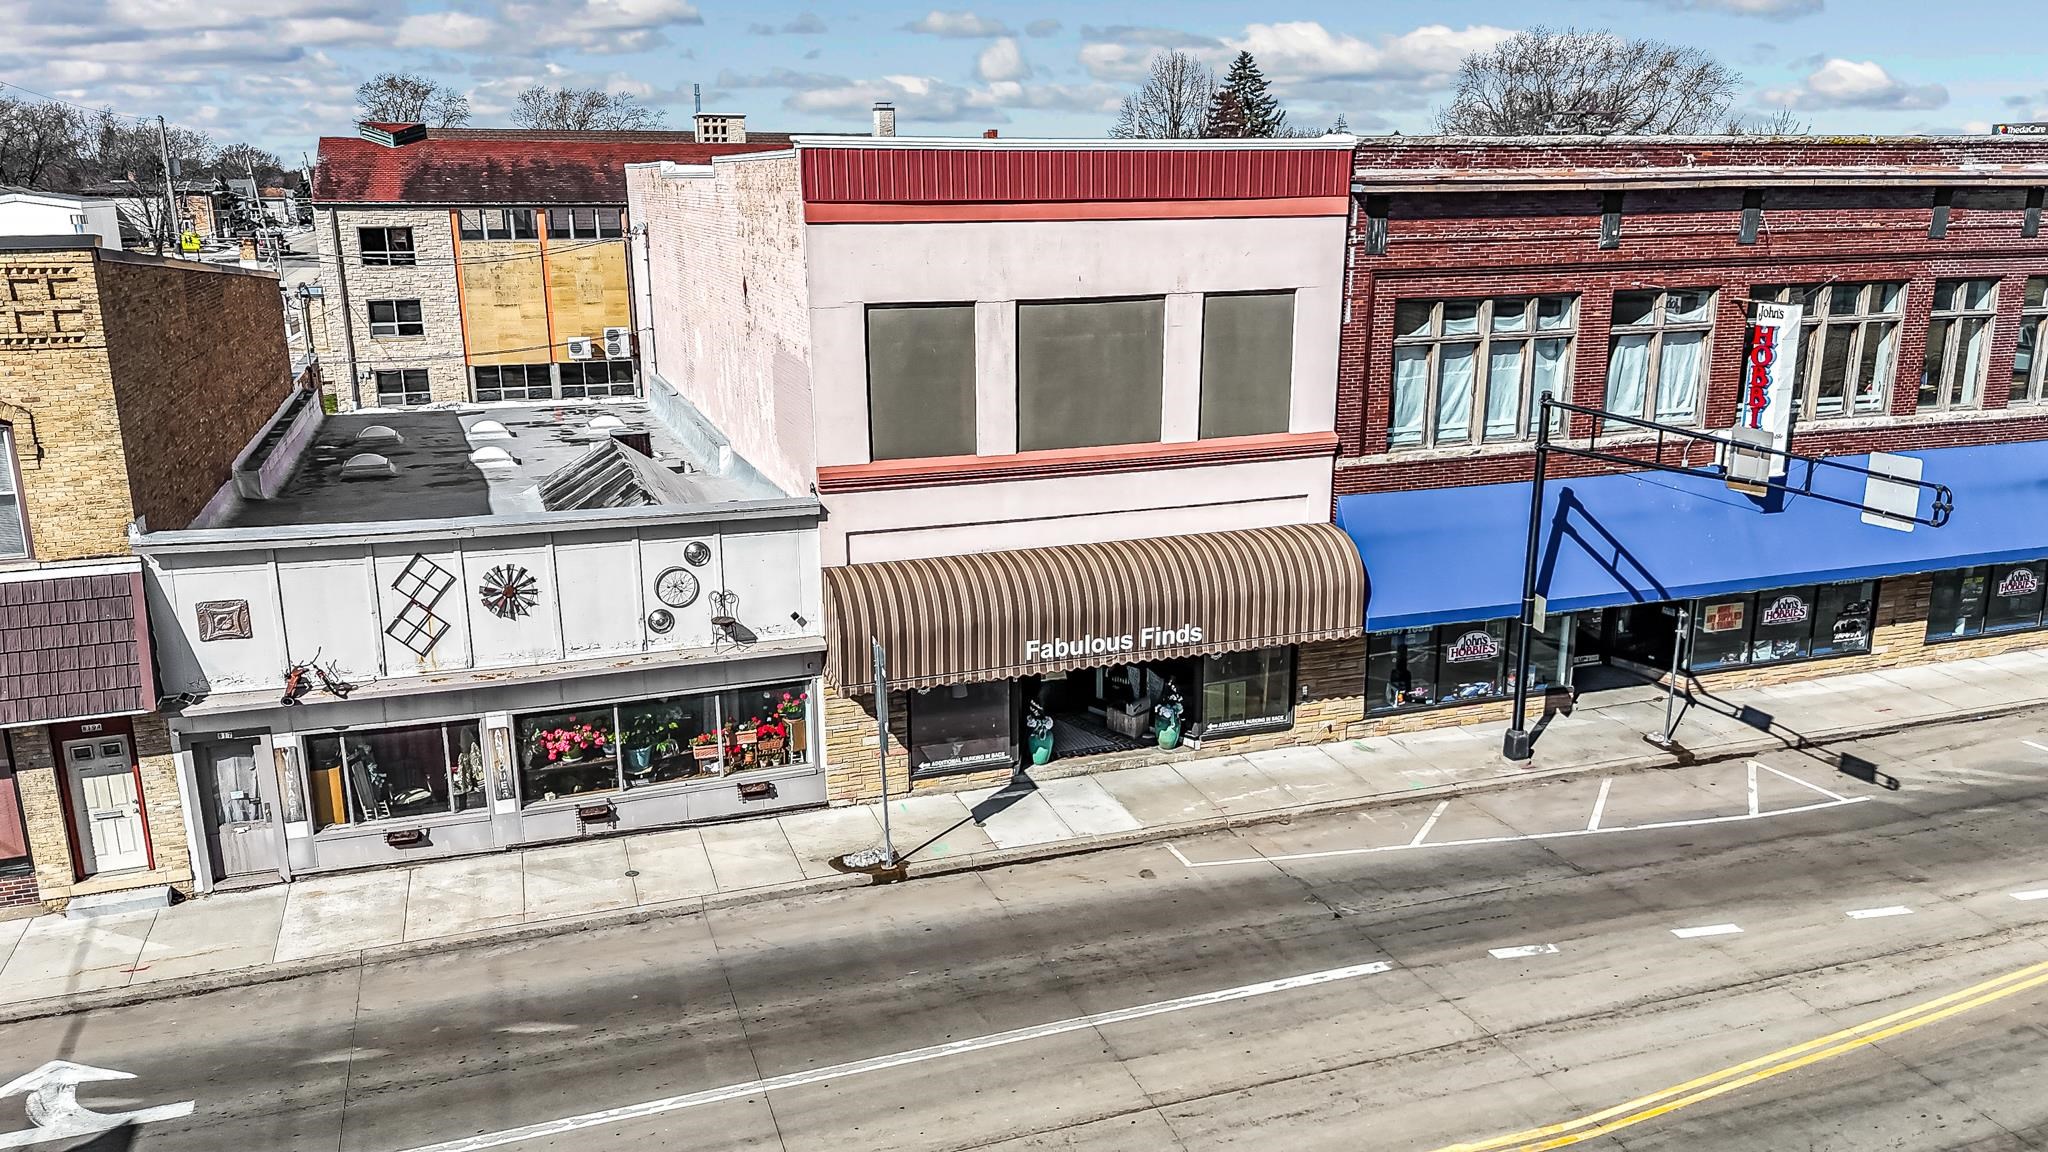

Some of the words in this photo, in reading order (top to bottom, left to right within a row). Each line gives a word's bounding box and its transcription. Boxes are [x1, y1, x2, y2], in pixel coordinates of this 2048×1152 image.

[1759, 305, 1785, 321] John's
[1747, 325, 1778, 430] HOBBI
[1026, 634, 1133, 661] Fabulous
[1141, 624, 1202, 648] Finds
[1460, 634, 1488, 648] John's
[1451, 643, 1496, 657] HOBBIES
[932, 757, 961, 767] ADDITIONAL
[962, 754, 985, 763] PARKING
[282, 747, 297, 822] VINTAGE
